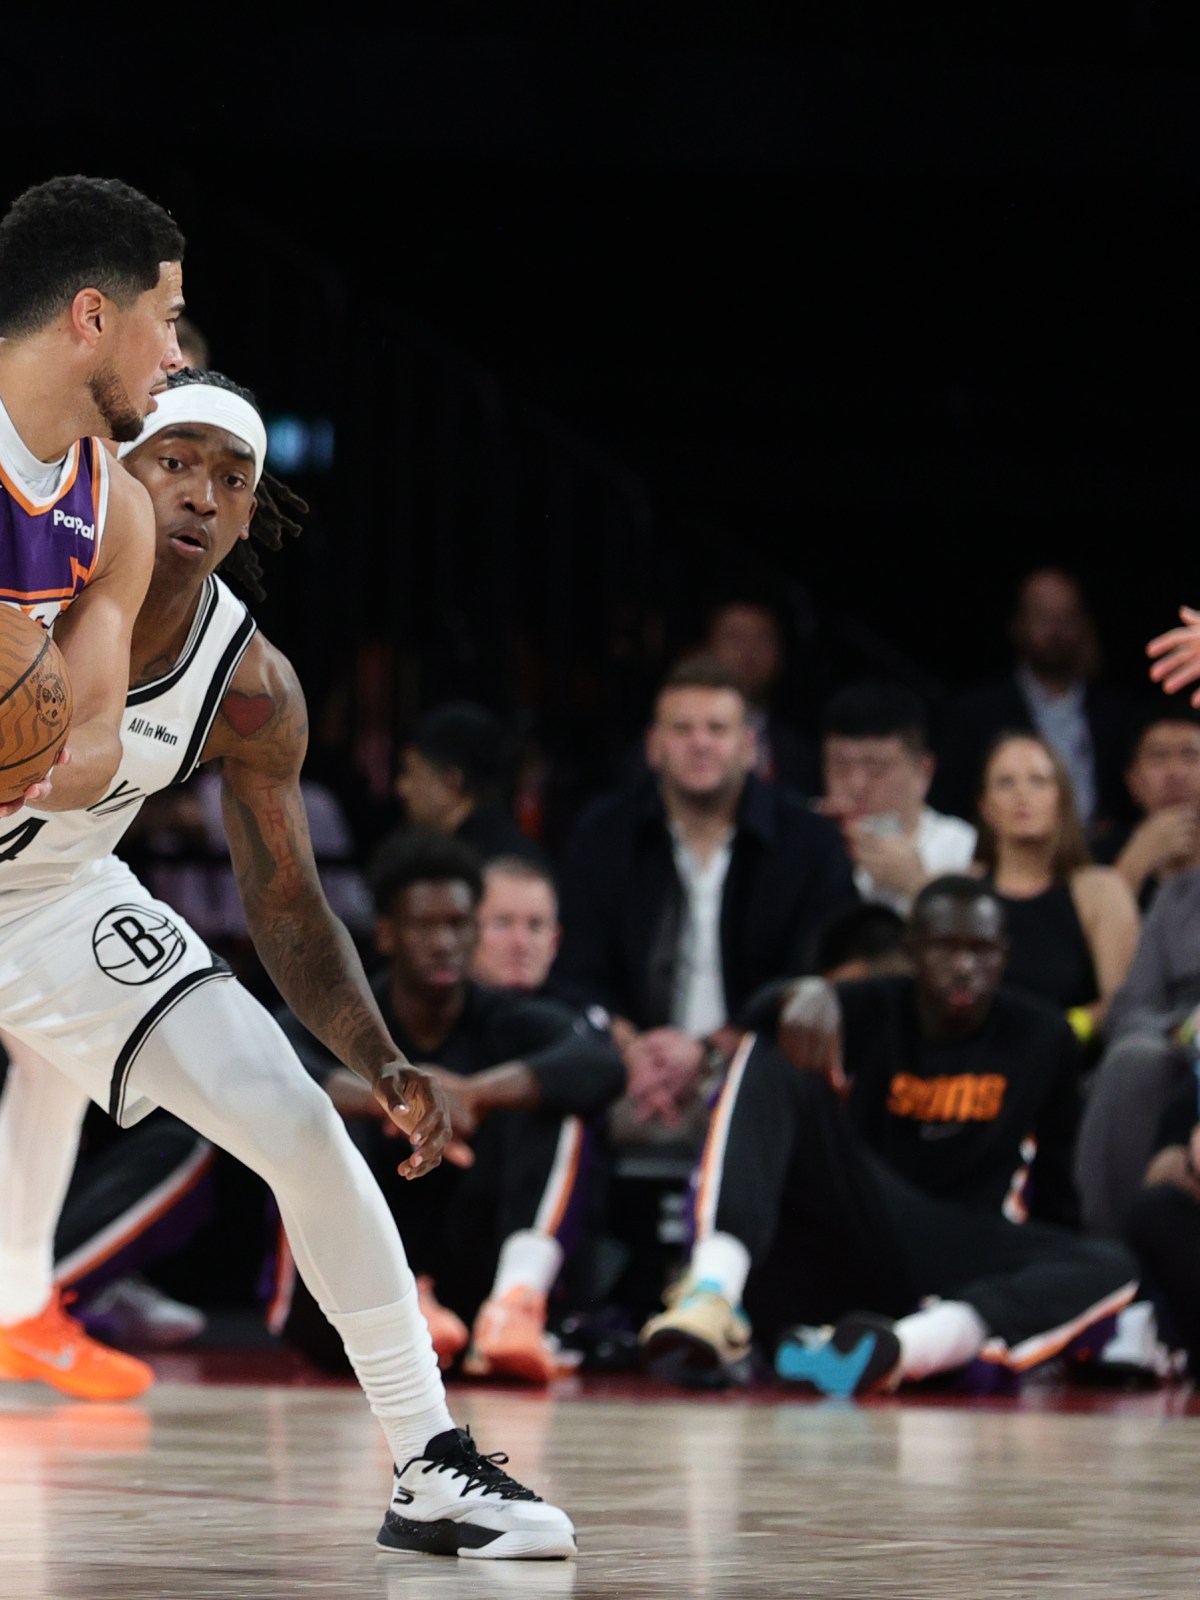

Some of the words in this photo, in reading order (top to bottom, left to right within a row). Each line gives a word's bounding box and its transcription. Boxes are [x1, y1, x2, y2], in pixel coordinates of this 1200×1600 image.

[128, 717, 145, 734] All
[143, 721, 154, 738] In
[153, 724, 178, 747] Won
[111, 916, 166, 970] B
